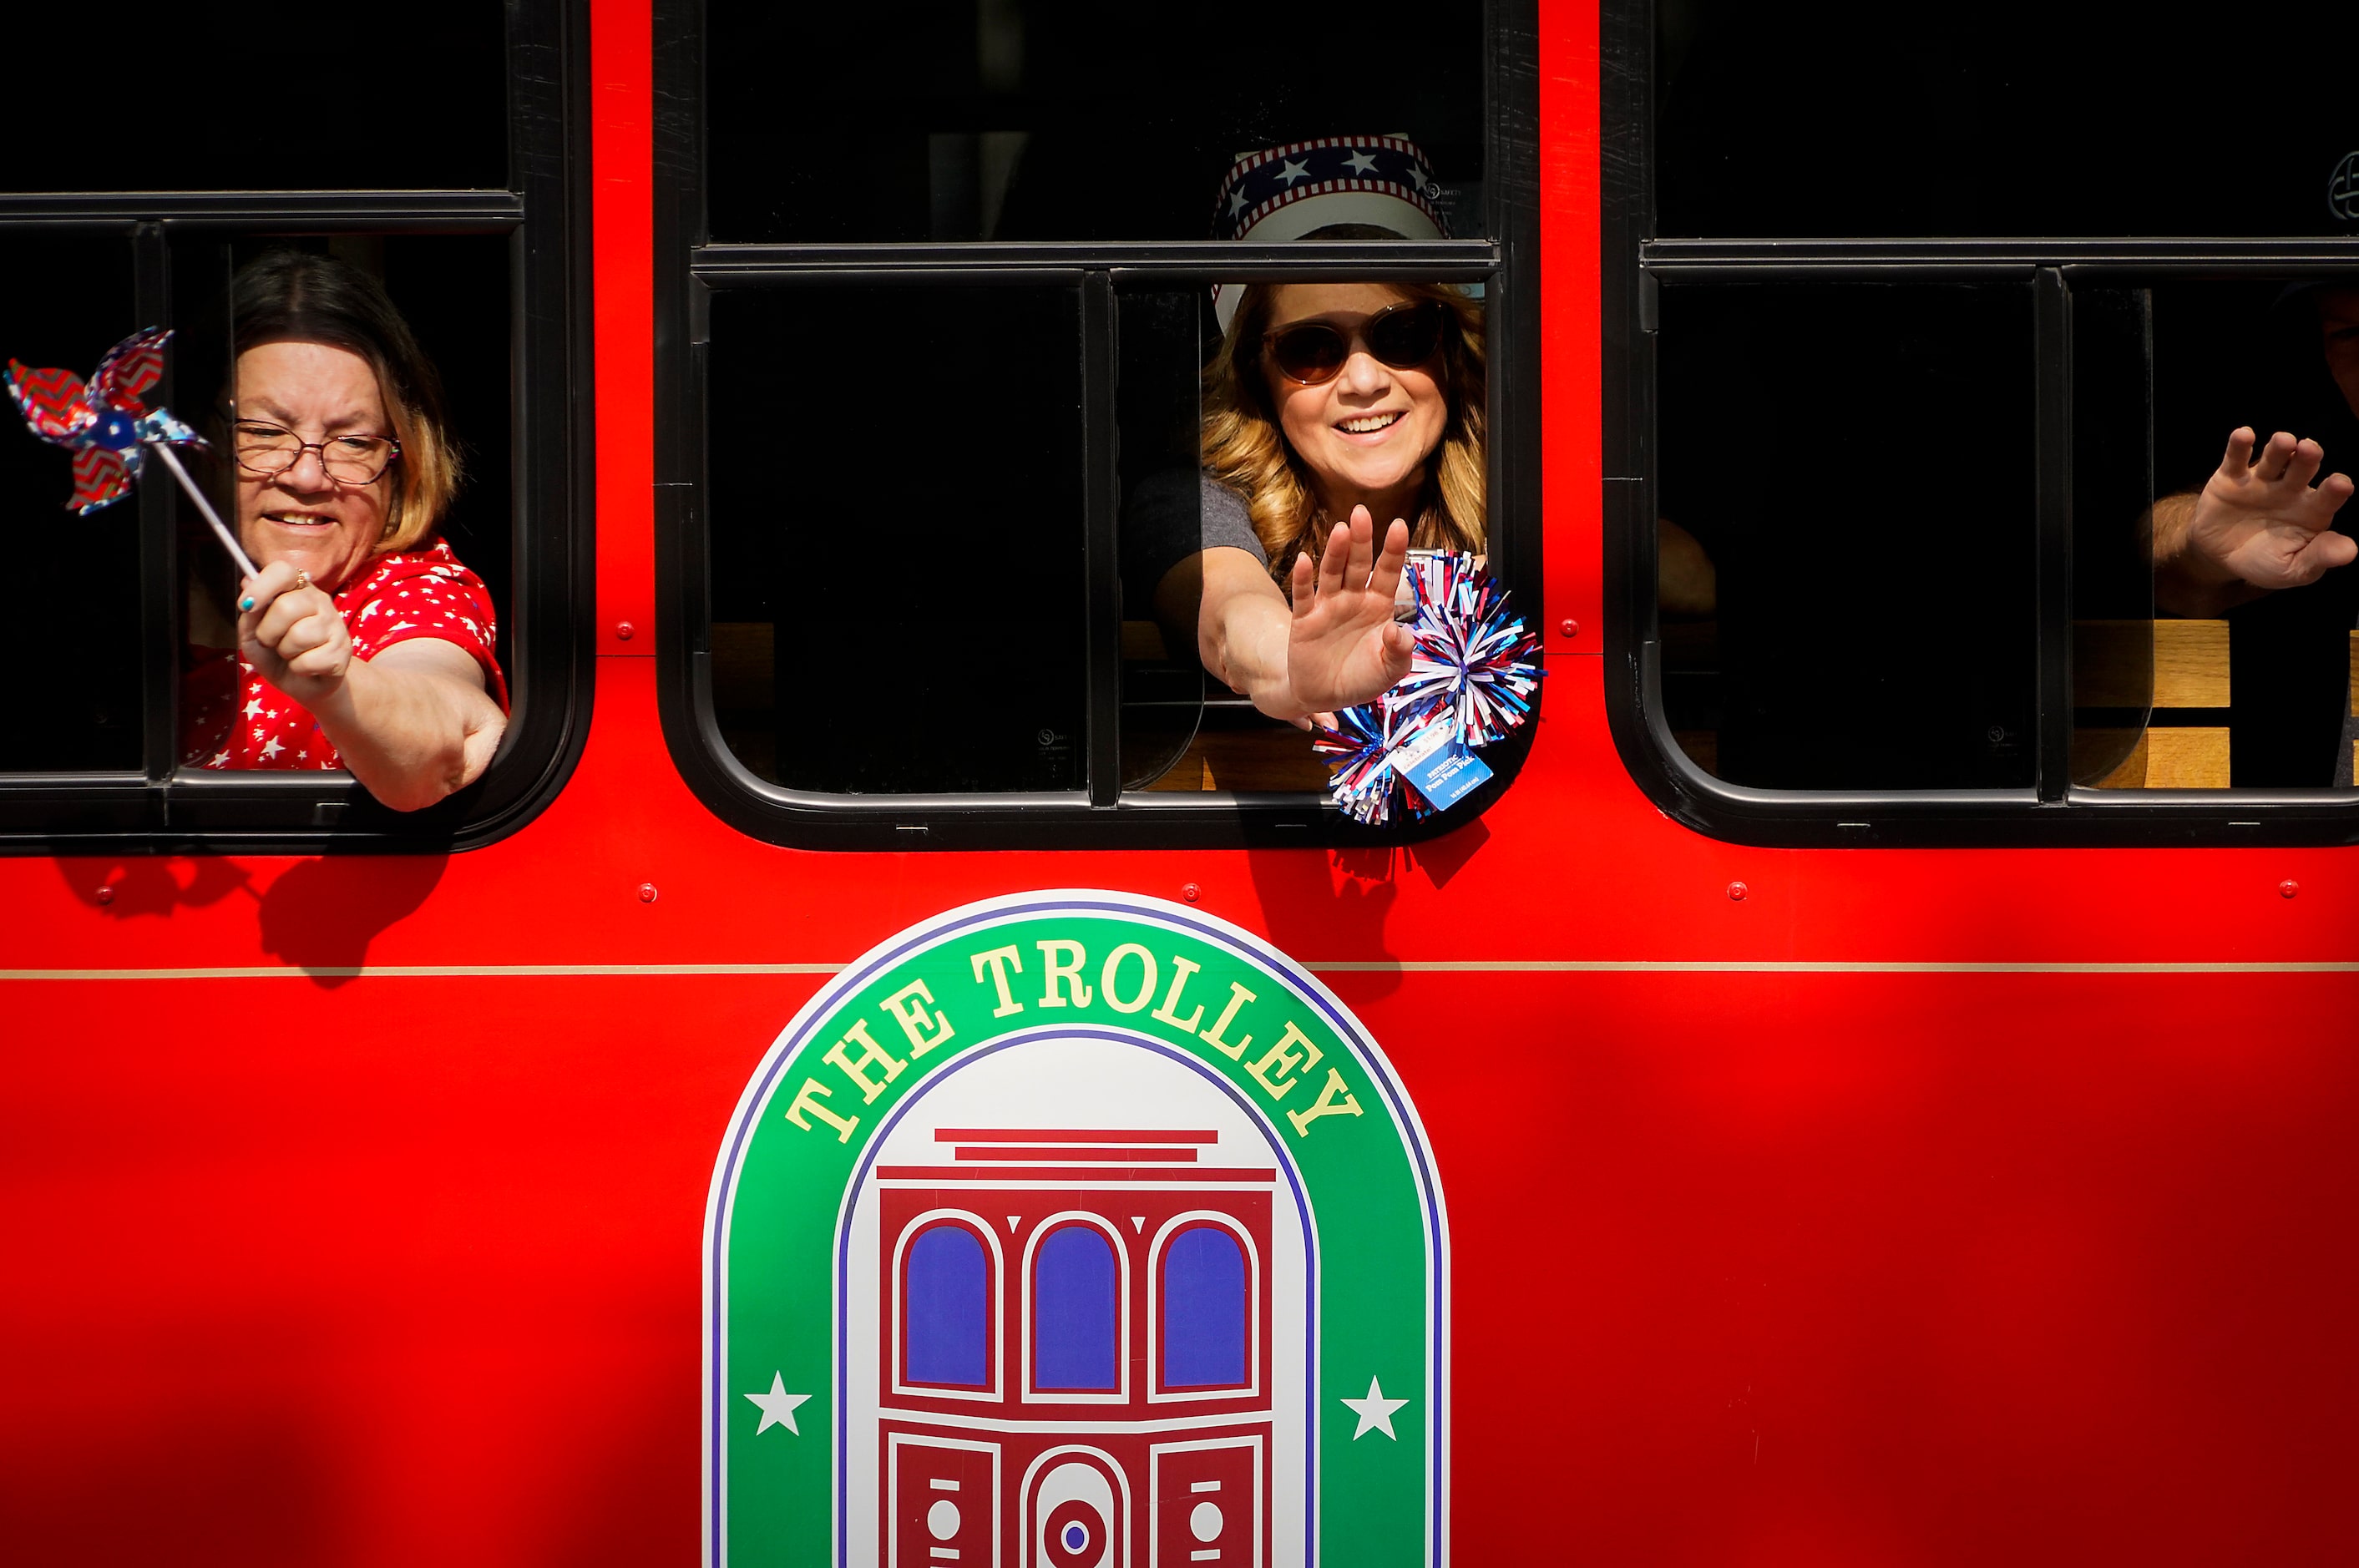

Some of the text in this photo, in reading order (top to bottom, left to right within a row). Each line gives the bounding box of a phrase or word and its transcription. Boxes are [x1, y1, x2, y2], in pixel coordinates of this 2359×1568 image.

[1425, 755, 1476, 792] Pom Pom Pick
[1427, 754, 1459, 779] PATRIOTIC
[785, 939, 1364, 1145] THE TROLLEY
